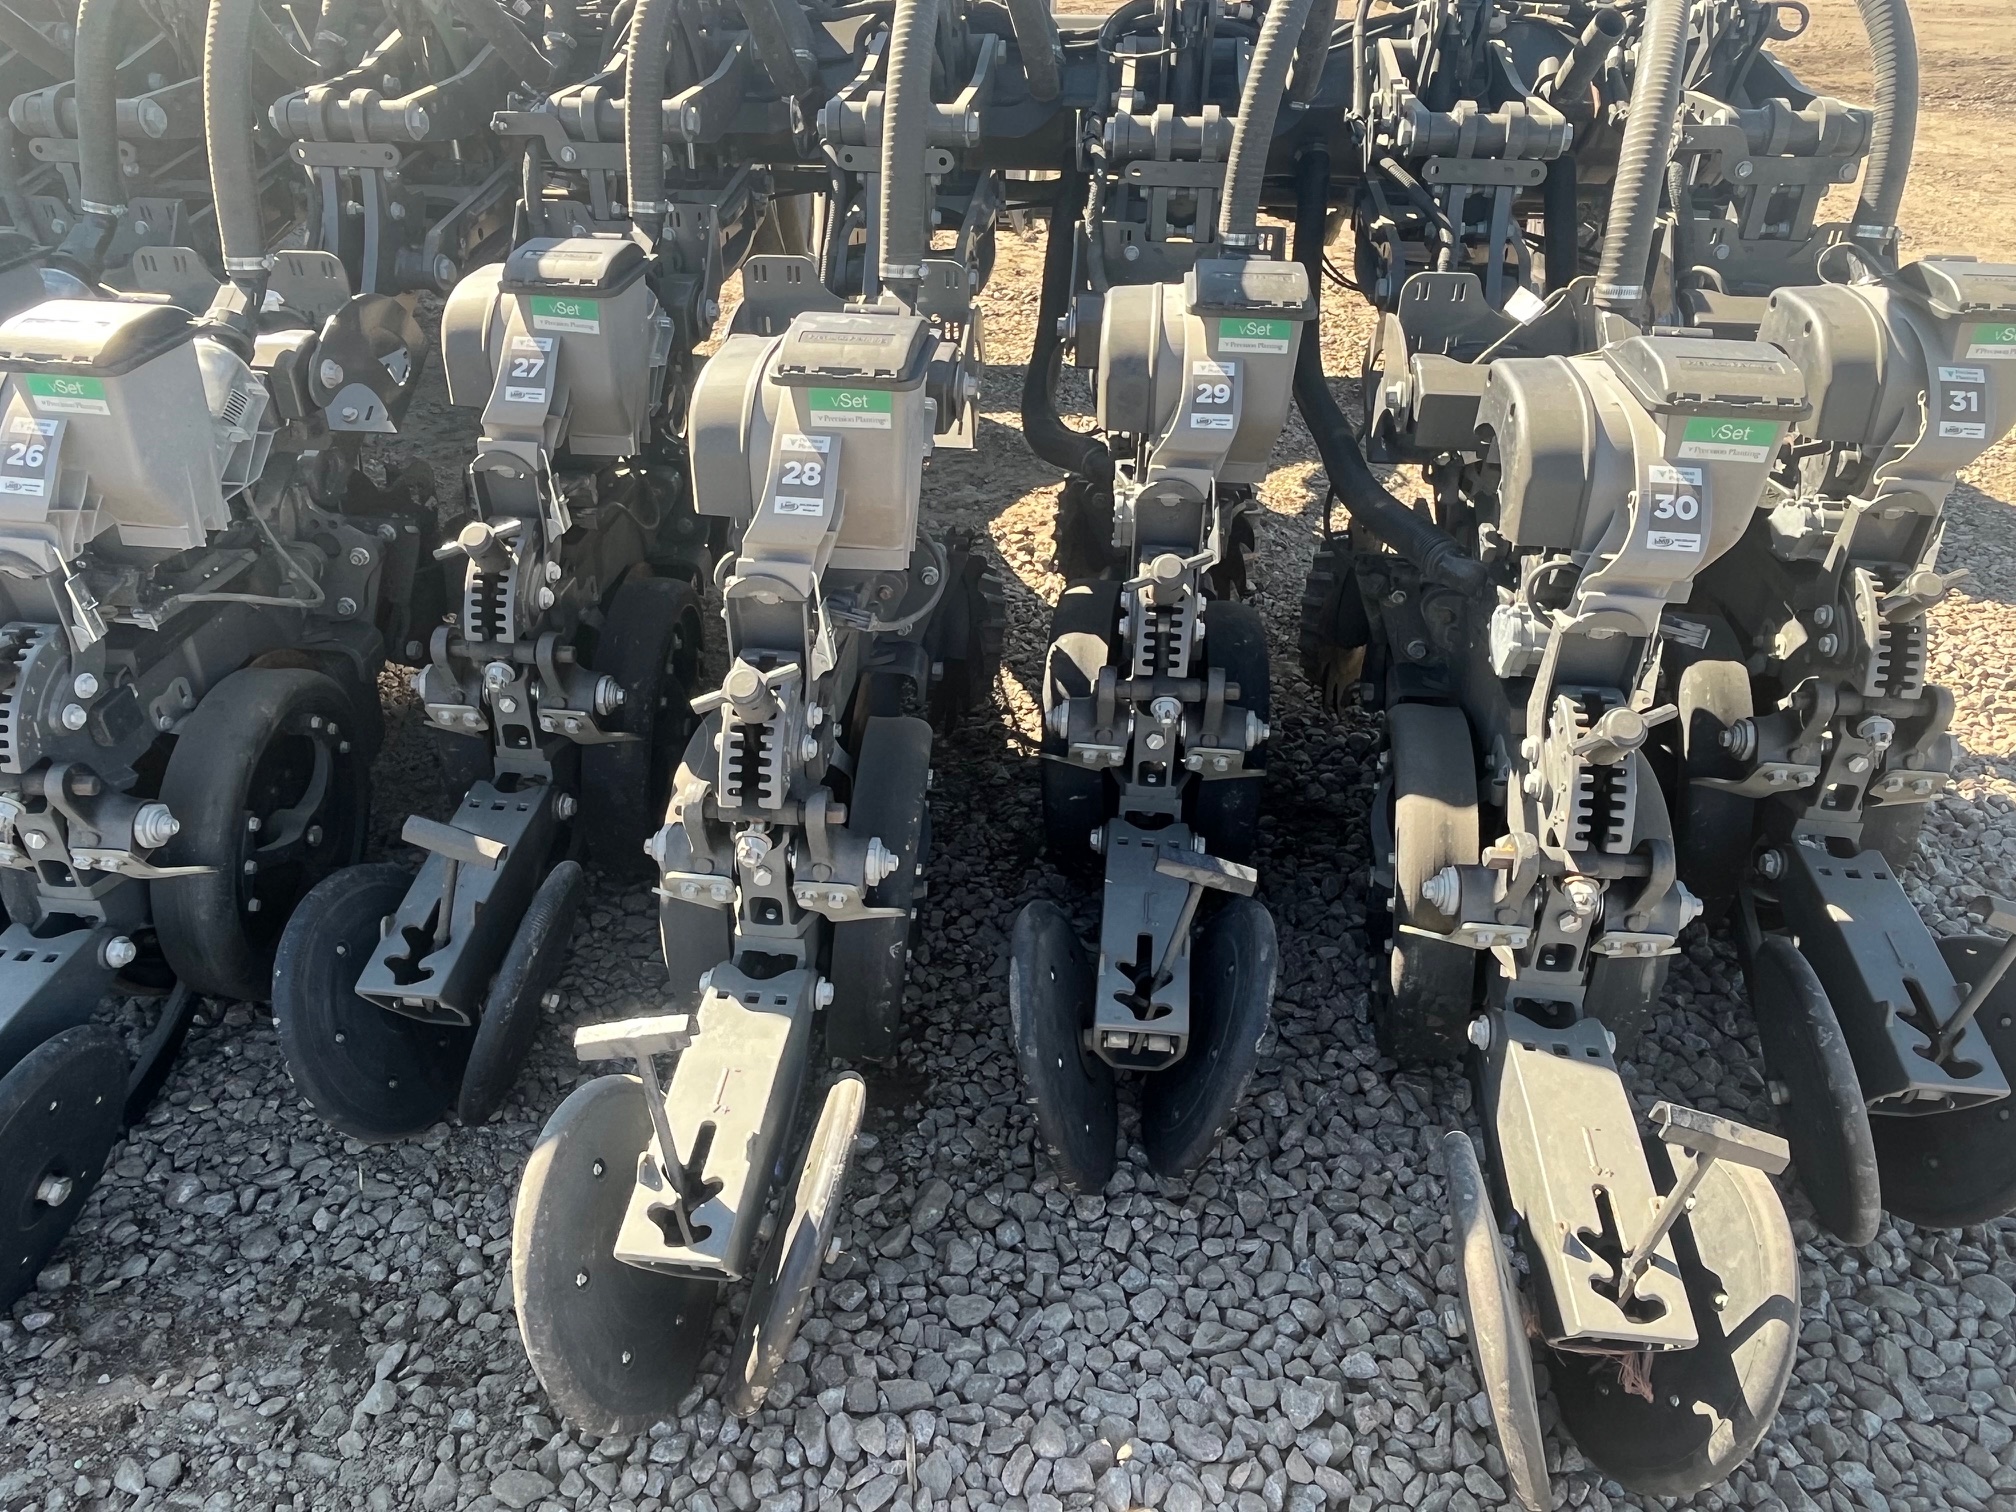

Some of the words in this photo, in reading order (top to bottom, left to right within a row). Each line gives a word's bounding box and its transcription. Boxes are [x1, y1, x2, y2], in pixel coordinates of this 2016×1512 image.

[549, 301, 580, 316] vSet
[1239, 321, 1272, 336] vSet
[1995, 327, 2016, 342] vS
[511, 357, 545, 378] 27
[47, 379, 85, 395] vSet
[1196, 383, 1231, 404] 29
[831, 392, 869, 408] vSet
[1949, 390, 1978, 412] 31
[1710, 423, 1754, 441] vSet
[6, 442, 45, 468] 26
[781, 460, 822, 486] 28
[1653, 493, 1699, 521] 30
